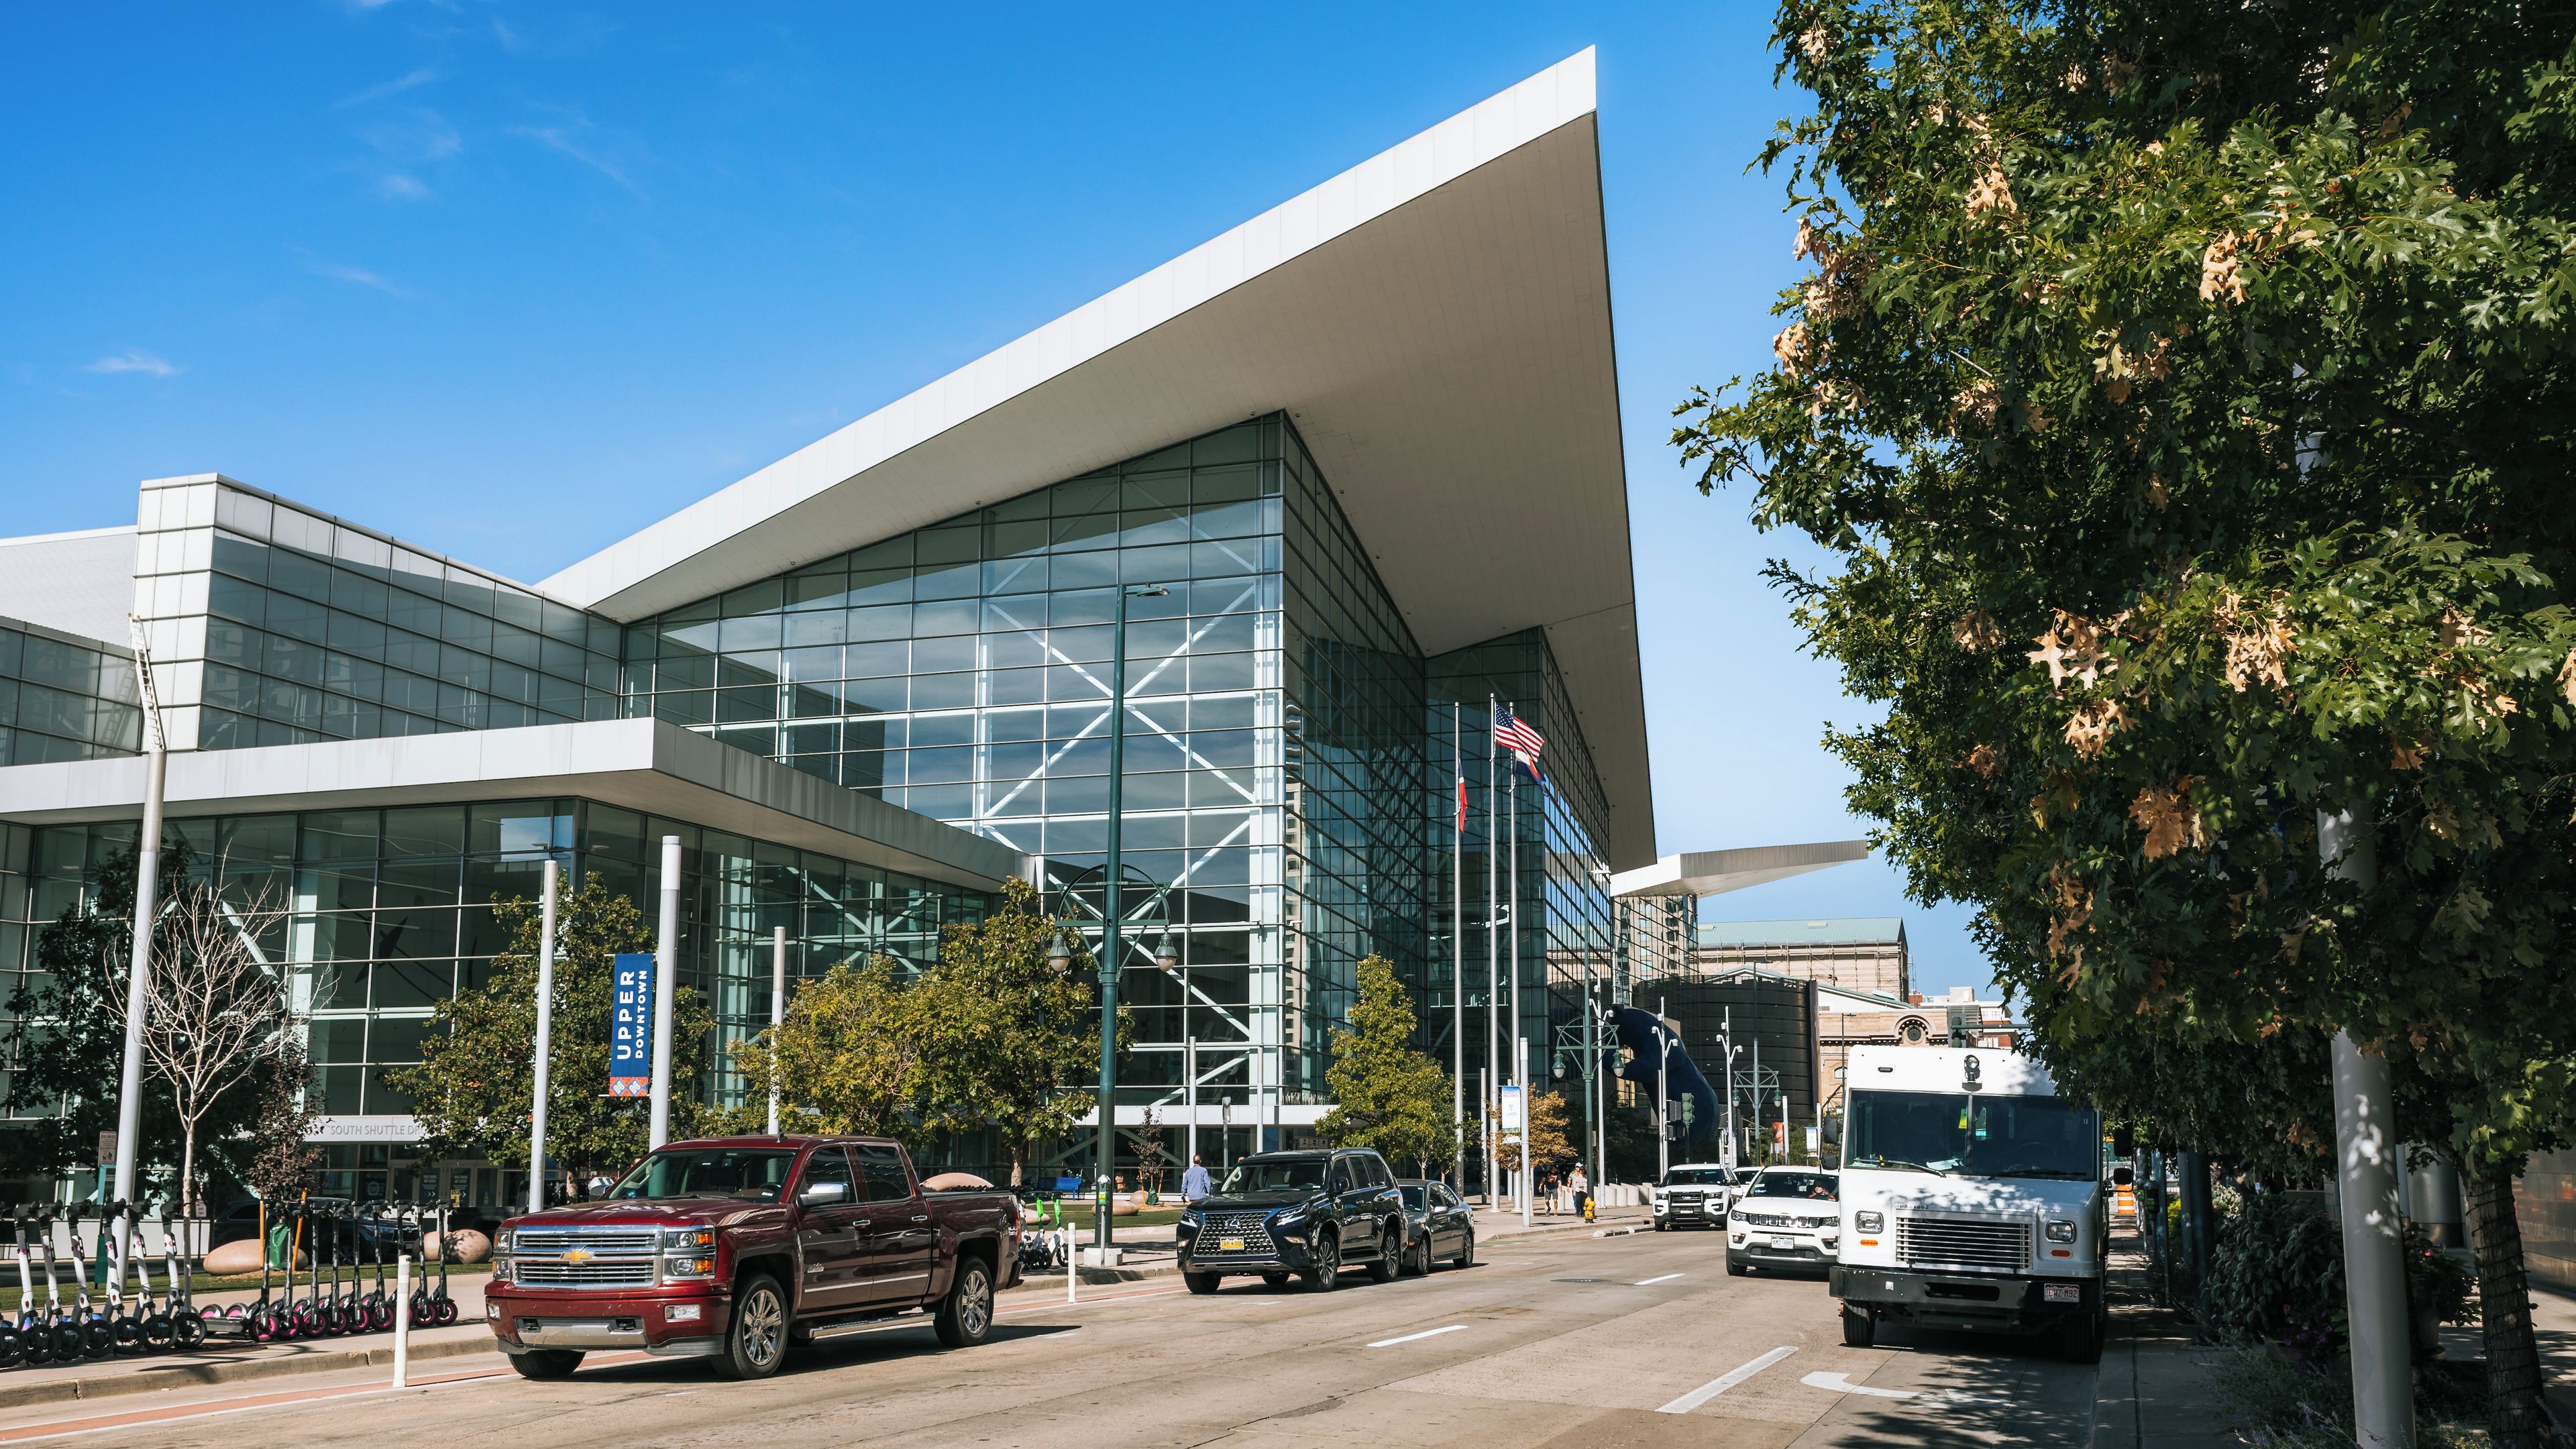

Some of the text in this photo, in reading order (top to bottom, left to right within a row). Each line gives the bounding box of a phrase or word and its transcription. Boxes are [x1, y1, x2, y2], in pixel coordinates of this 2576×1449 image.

[616, 971, 635, 1060] UPPER
[635, 970, 647, 1059] DOWNTOWN
[331, 1125, 362, 1135] SOUTH
[364, 1125, 405, 1135] SHUTTLE
